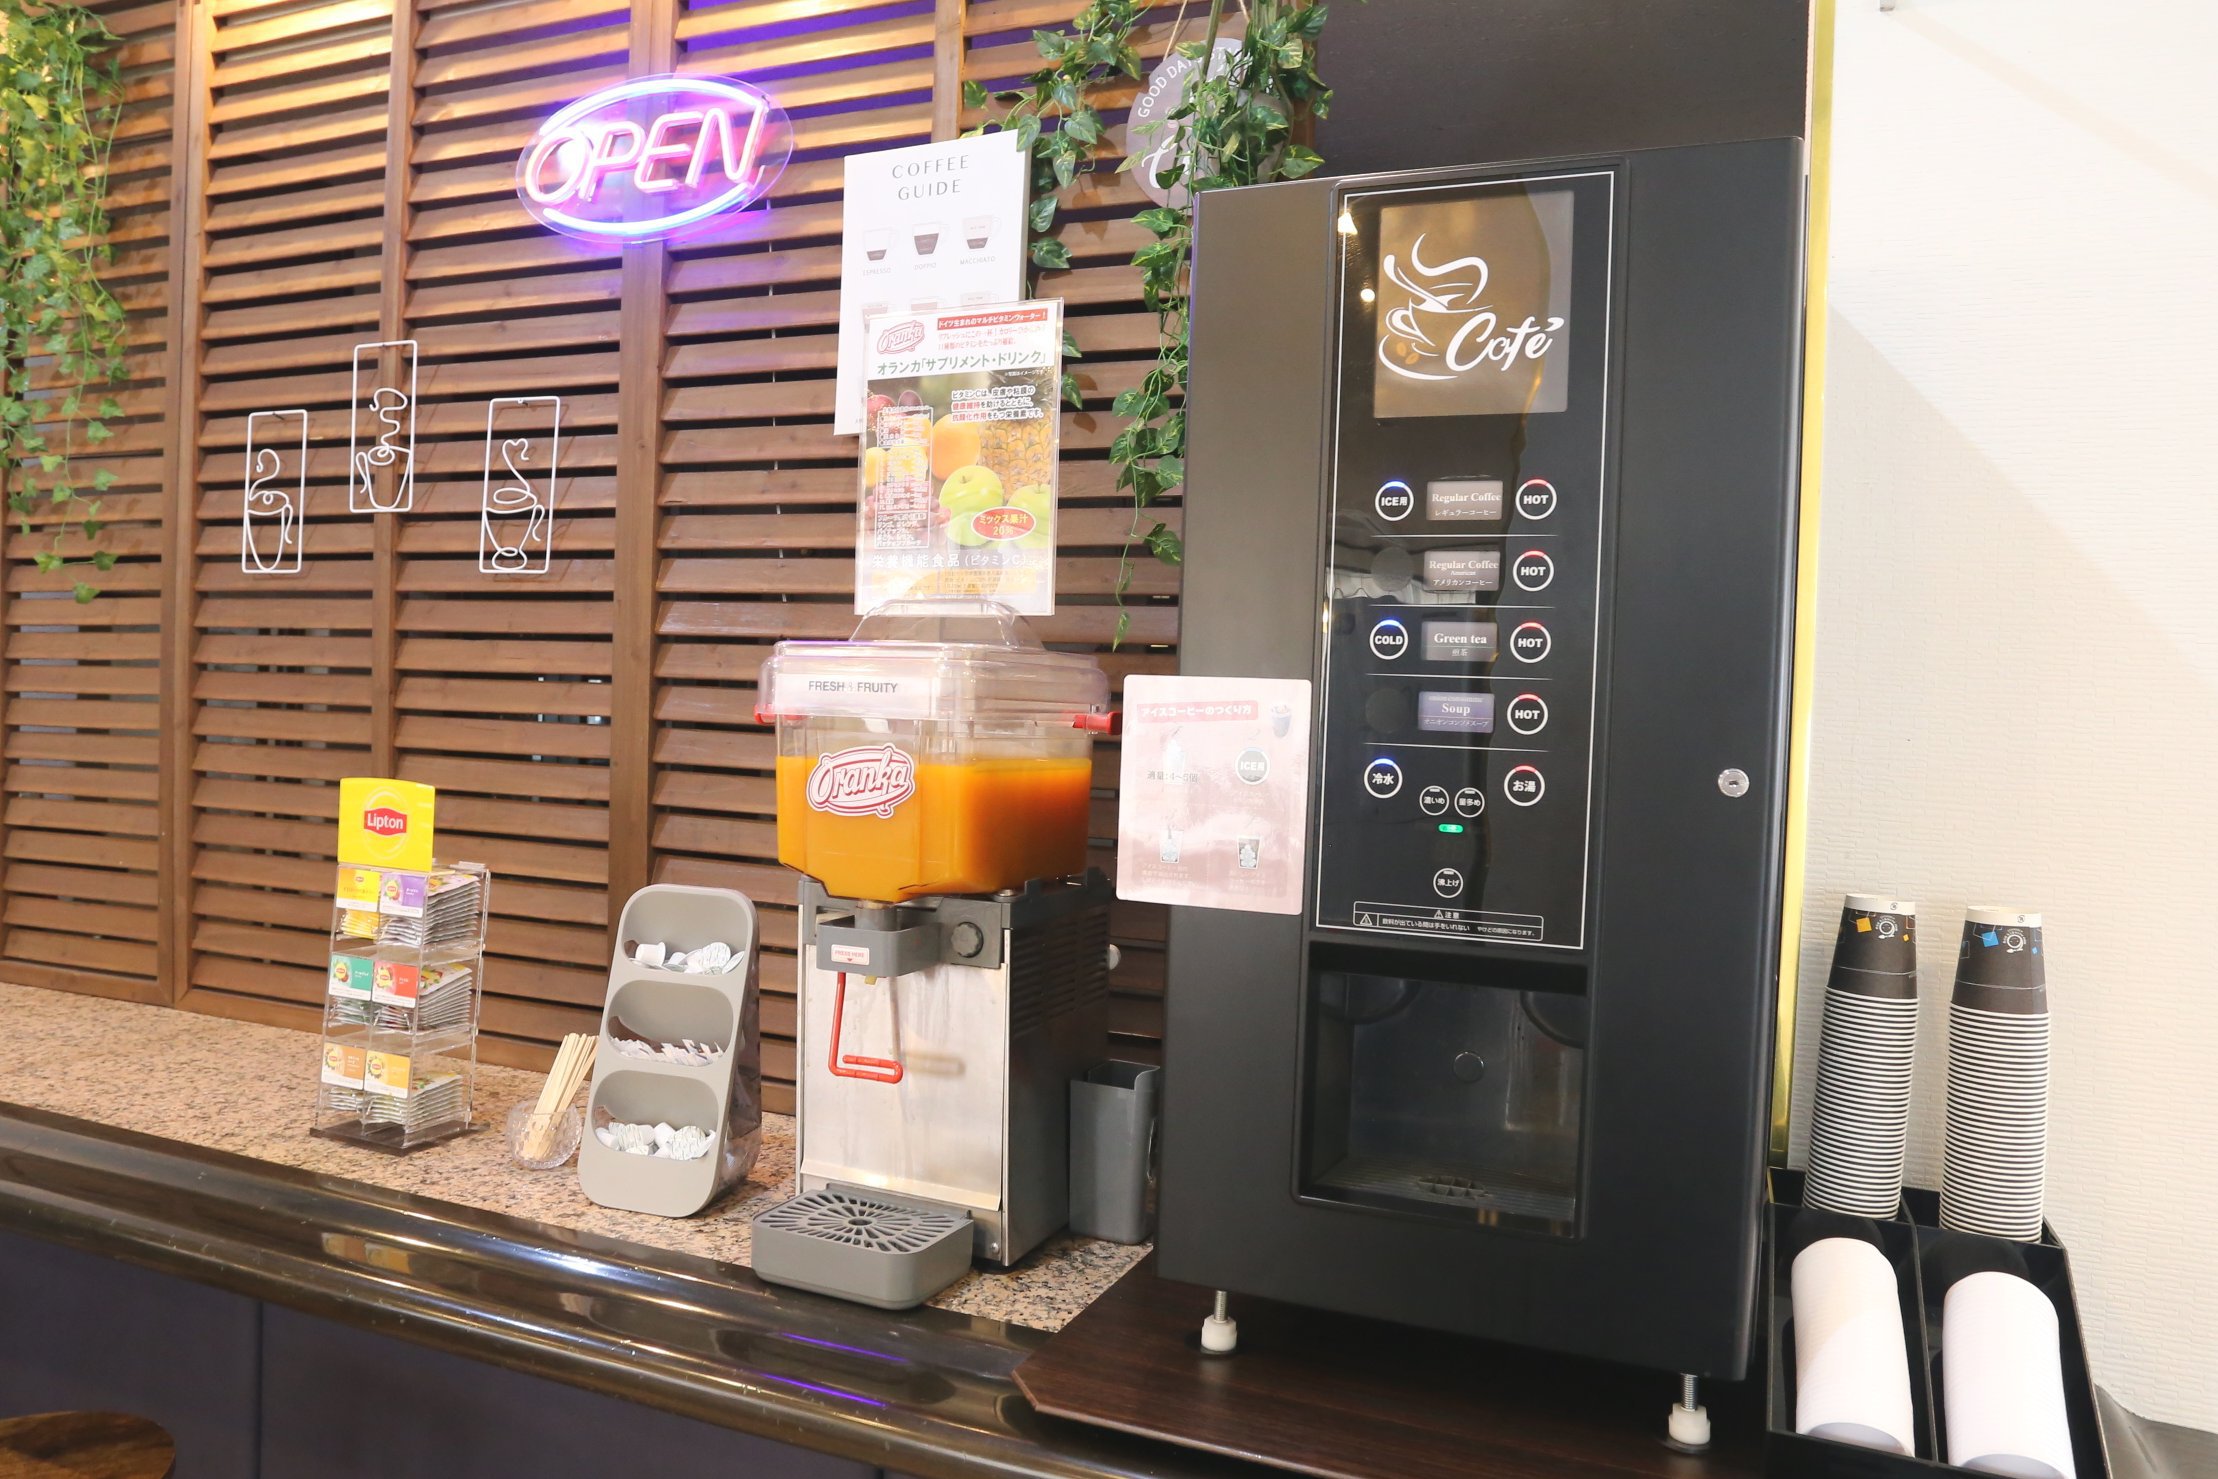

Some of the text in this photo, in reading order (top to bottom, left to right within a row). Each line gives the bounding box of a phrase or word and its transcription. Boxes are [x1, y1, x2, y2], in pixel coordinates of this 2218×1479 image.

[1138, 76, 1168, 118] GOOD
[525, 100, 768, 204] OPEN
[892, 154, 969, 179] COFFEE
[898, 178, 961, 201] GUIDE
[959, 255, 996, 266] MACCHIATO
[1381, 496, 1408, 507] ICE用
[1432, 492, 1501, 504] Regular Coffee
[1523, 495, 1549, 505] HOT
[979, 513, 1028, 525] ミックス果汁
[1429, 560, 1499, 570] Regular Coffee
[1520, 566, 1546, 576] HOT
[1375, 636, 1403, 645] COLD
[1434, 633, 1487, 644] Green tea
[1517, 638, 1543, 648] HOT
[809, 681, 845, 692] FRESH
[857, 682, 898, 693] FRUITY
[1441, 702, 1471, 715] Soup
[1515, 710, 1540, 720] HOT
[810, 749, 911, 807] Oranka
[1372, 773, 1394, 785] 冷水
[1513, 780, 1536, 792] お湯
[1424, 796, 1445, 804] 濃いめ
[367, 813, 404, 830] Lipton
[1445, 911, 1460, 919] 注意
